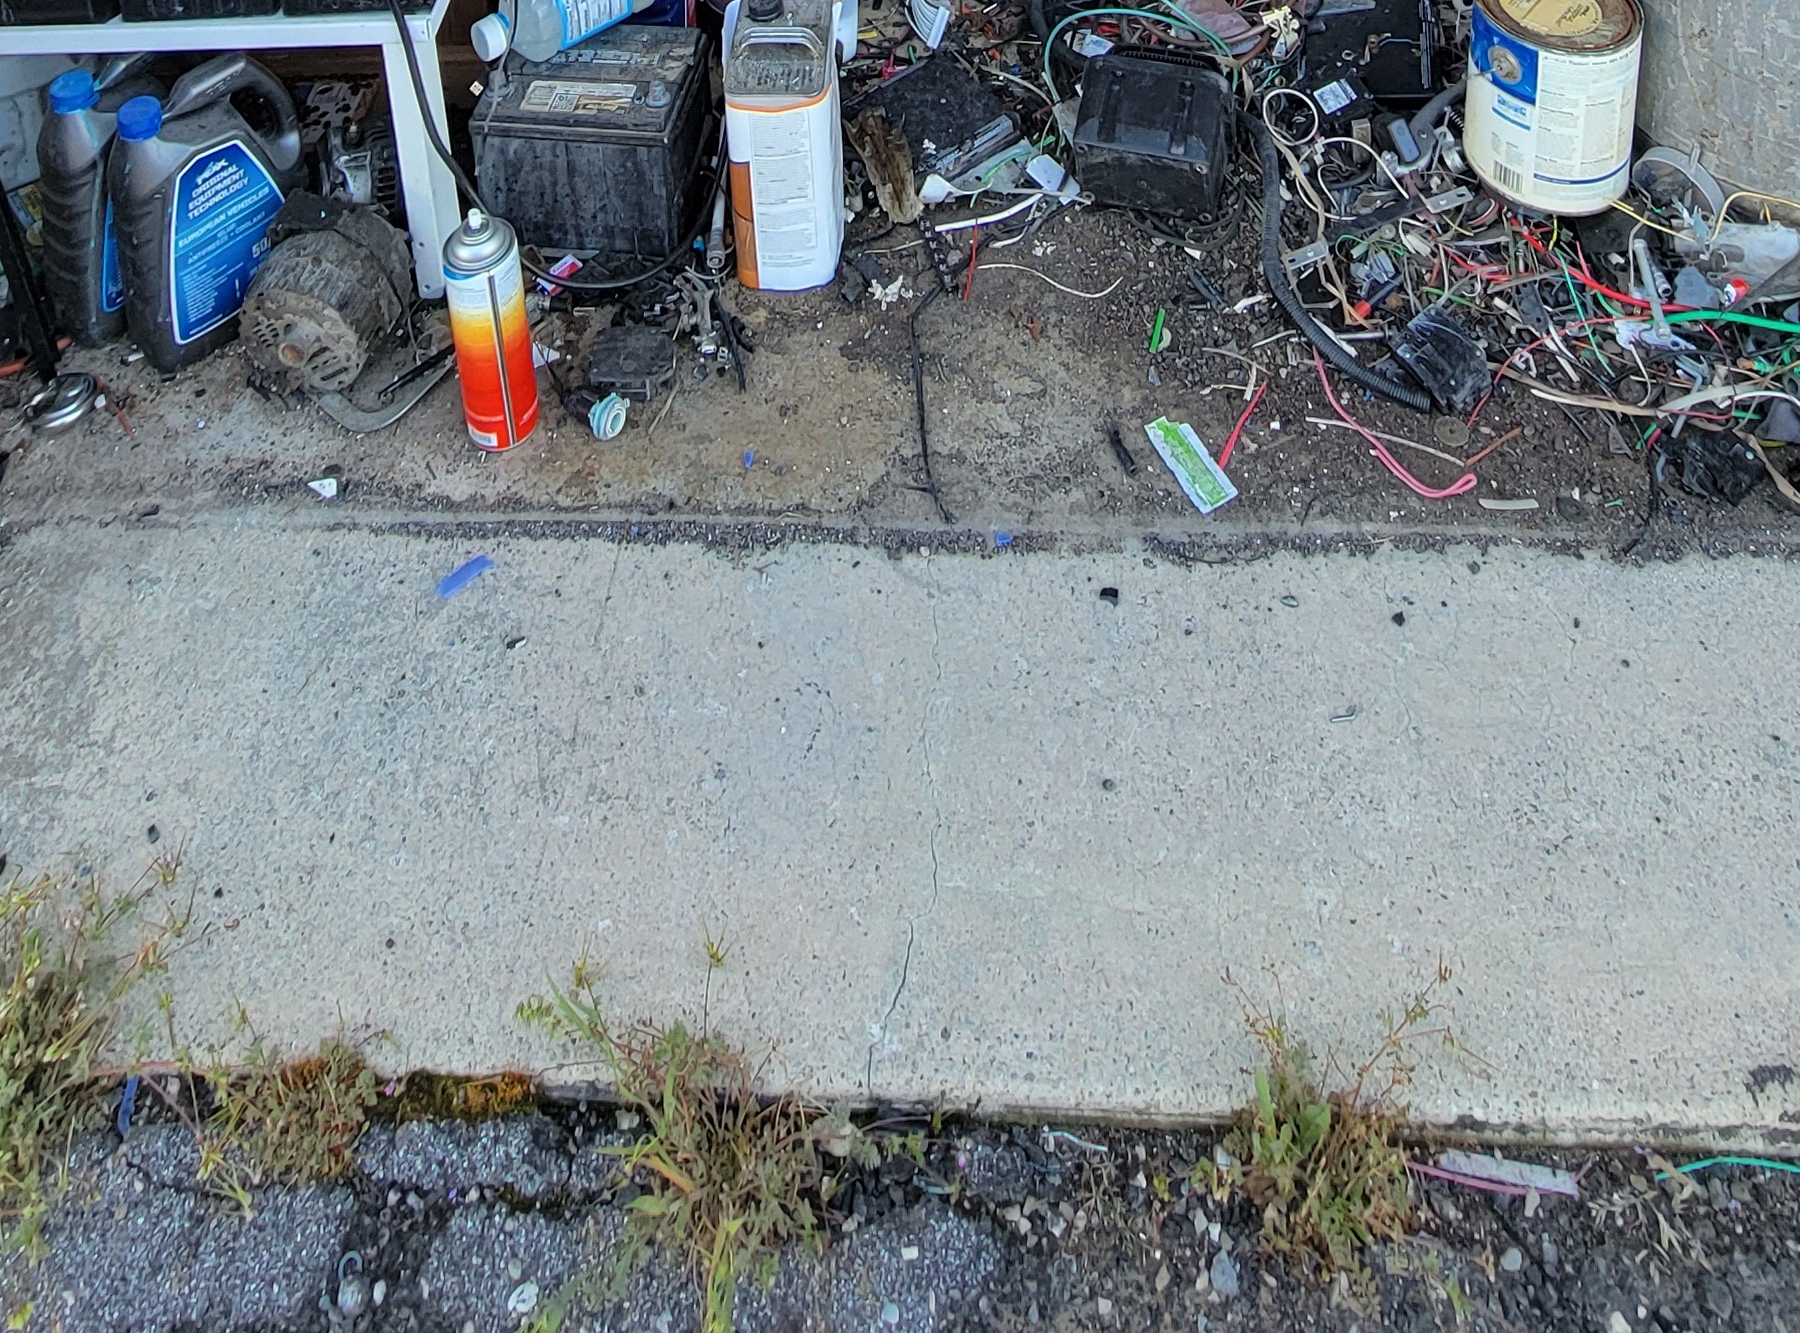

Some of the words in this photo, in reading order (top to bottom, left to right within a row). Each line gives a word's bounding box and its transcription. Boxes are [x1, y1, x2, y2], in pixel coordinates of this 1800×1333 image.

[187, 176, 249, 220] TECHNOLOGY
[188, 169, 245, 211] EQUIPMENT
[191, 164, 239, 199] ORIGINAL
[178, 212, 226, 248] EUROPEAN
[226, 186, 270, 217] VEHICLES
